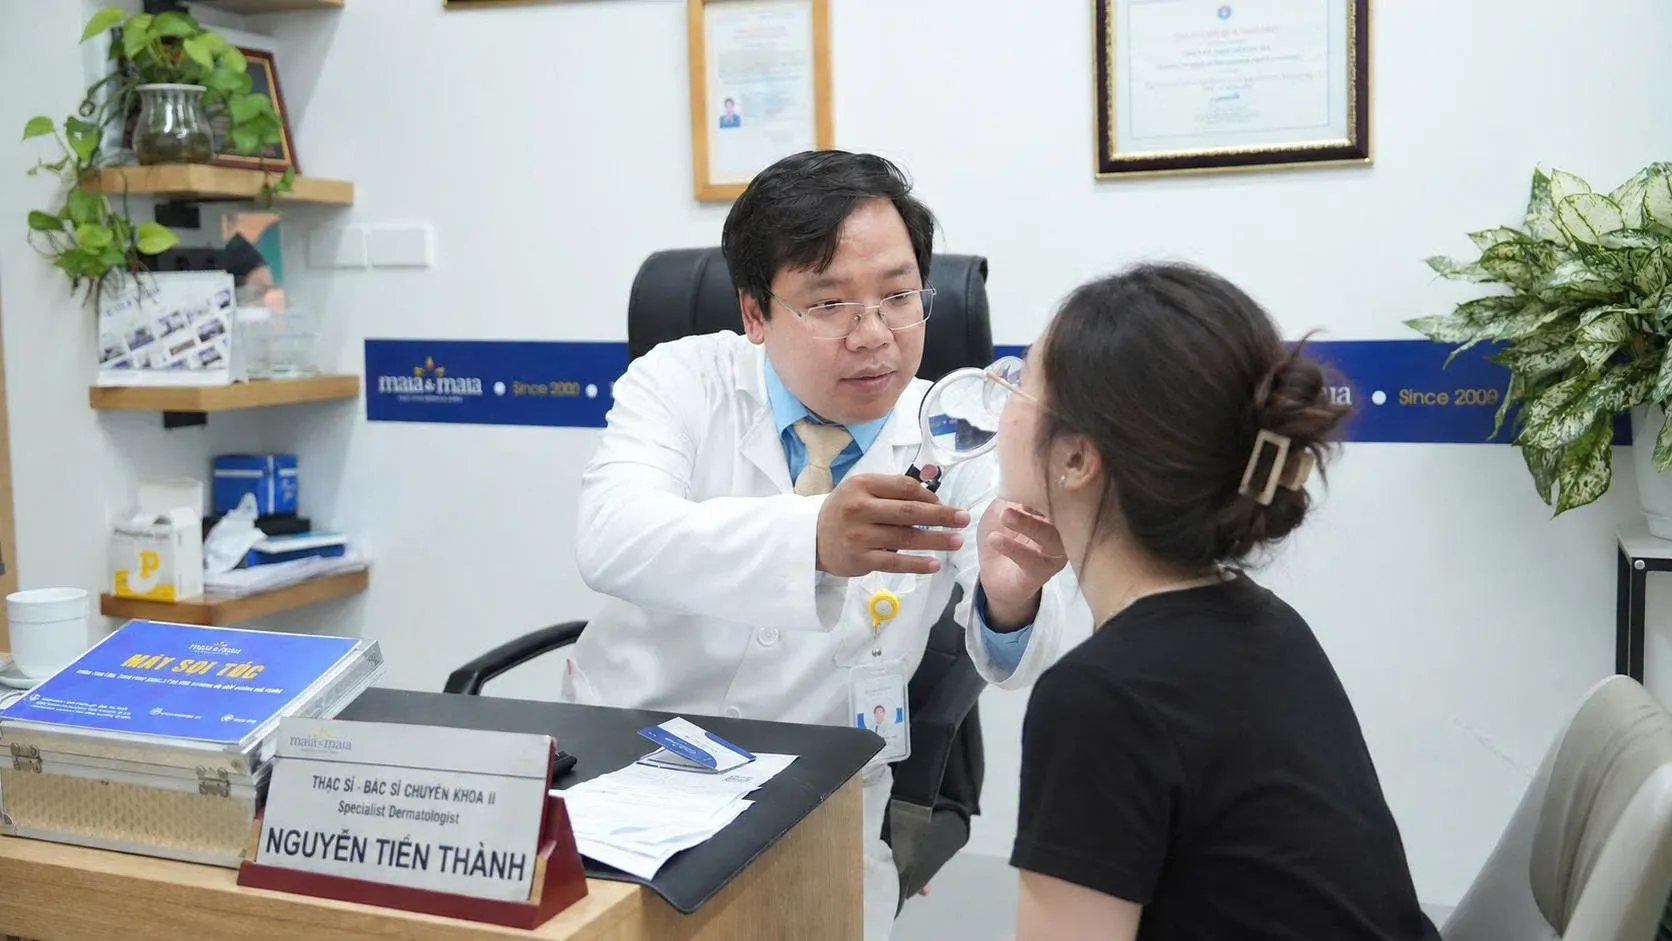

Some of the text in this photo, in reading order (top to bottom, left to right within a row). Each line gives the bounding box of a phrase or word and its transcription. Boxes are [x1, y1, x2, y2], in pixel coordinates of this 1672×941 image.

[512, 380, 548, 397] Since
[1398, 388, 1450, 406] Since
[312, 774, 341, 795] THẠC
[452, 787, 484, 805] KHOA
[337, 799, 461, 826] Specialist Dermatologist
[265, 827, 368, 865] NGUYỄN
[438, 841, 527, 881] THÀNH
